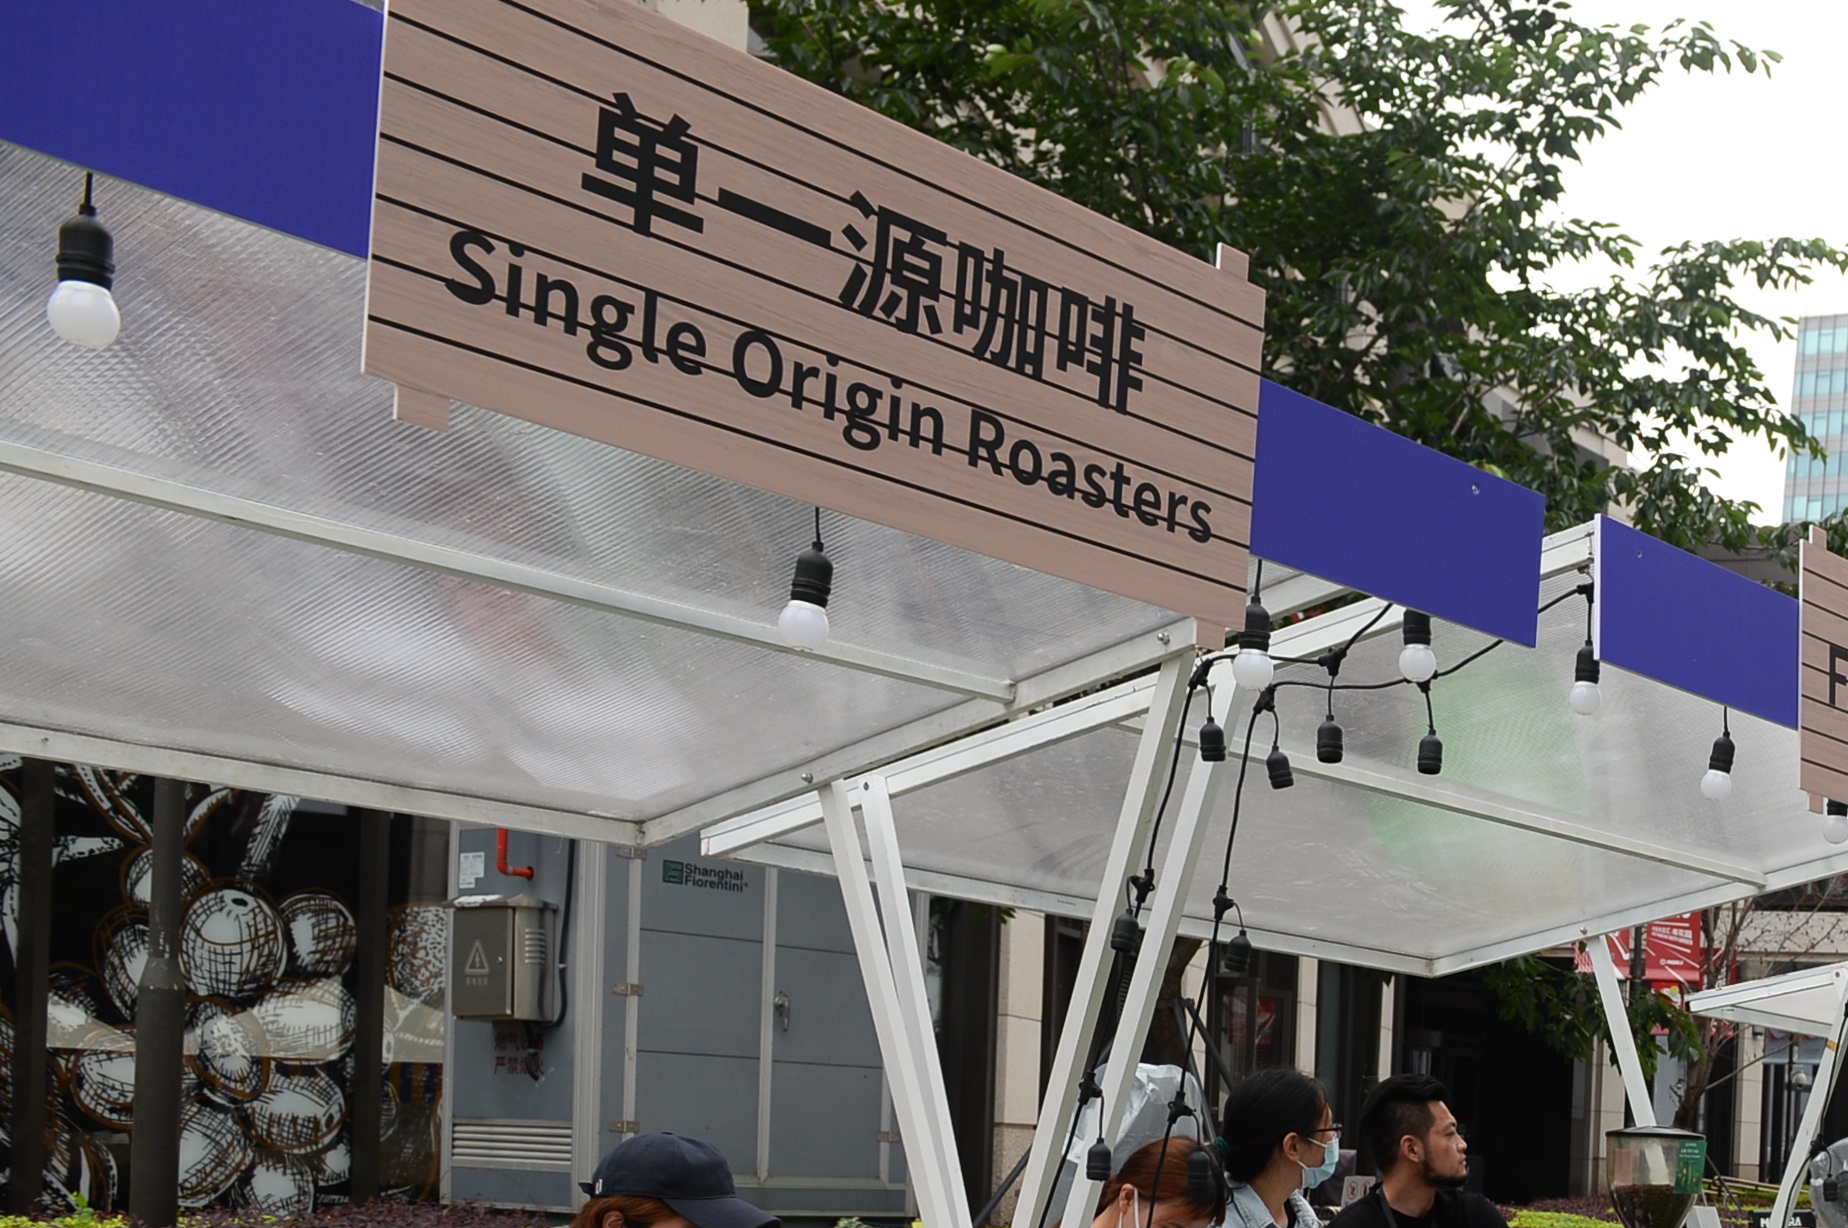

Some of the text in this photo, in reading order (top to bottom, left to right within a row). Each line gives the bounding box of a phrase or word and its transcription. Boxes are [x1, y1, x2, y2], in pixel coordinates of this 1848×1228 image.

[581, 92, 1146, 413] 单一源咖啡
[444, 229, 1215, 545] Single Origin Roasters
[684, 862, 745, 882] Shanghai
[684, 874, 744, 893] Fiorentini
